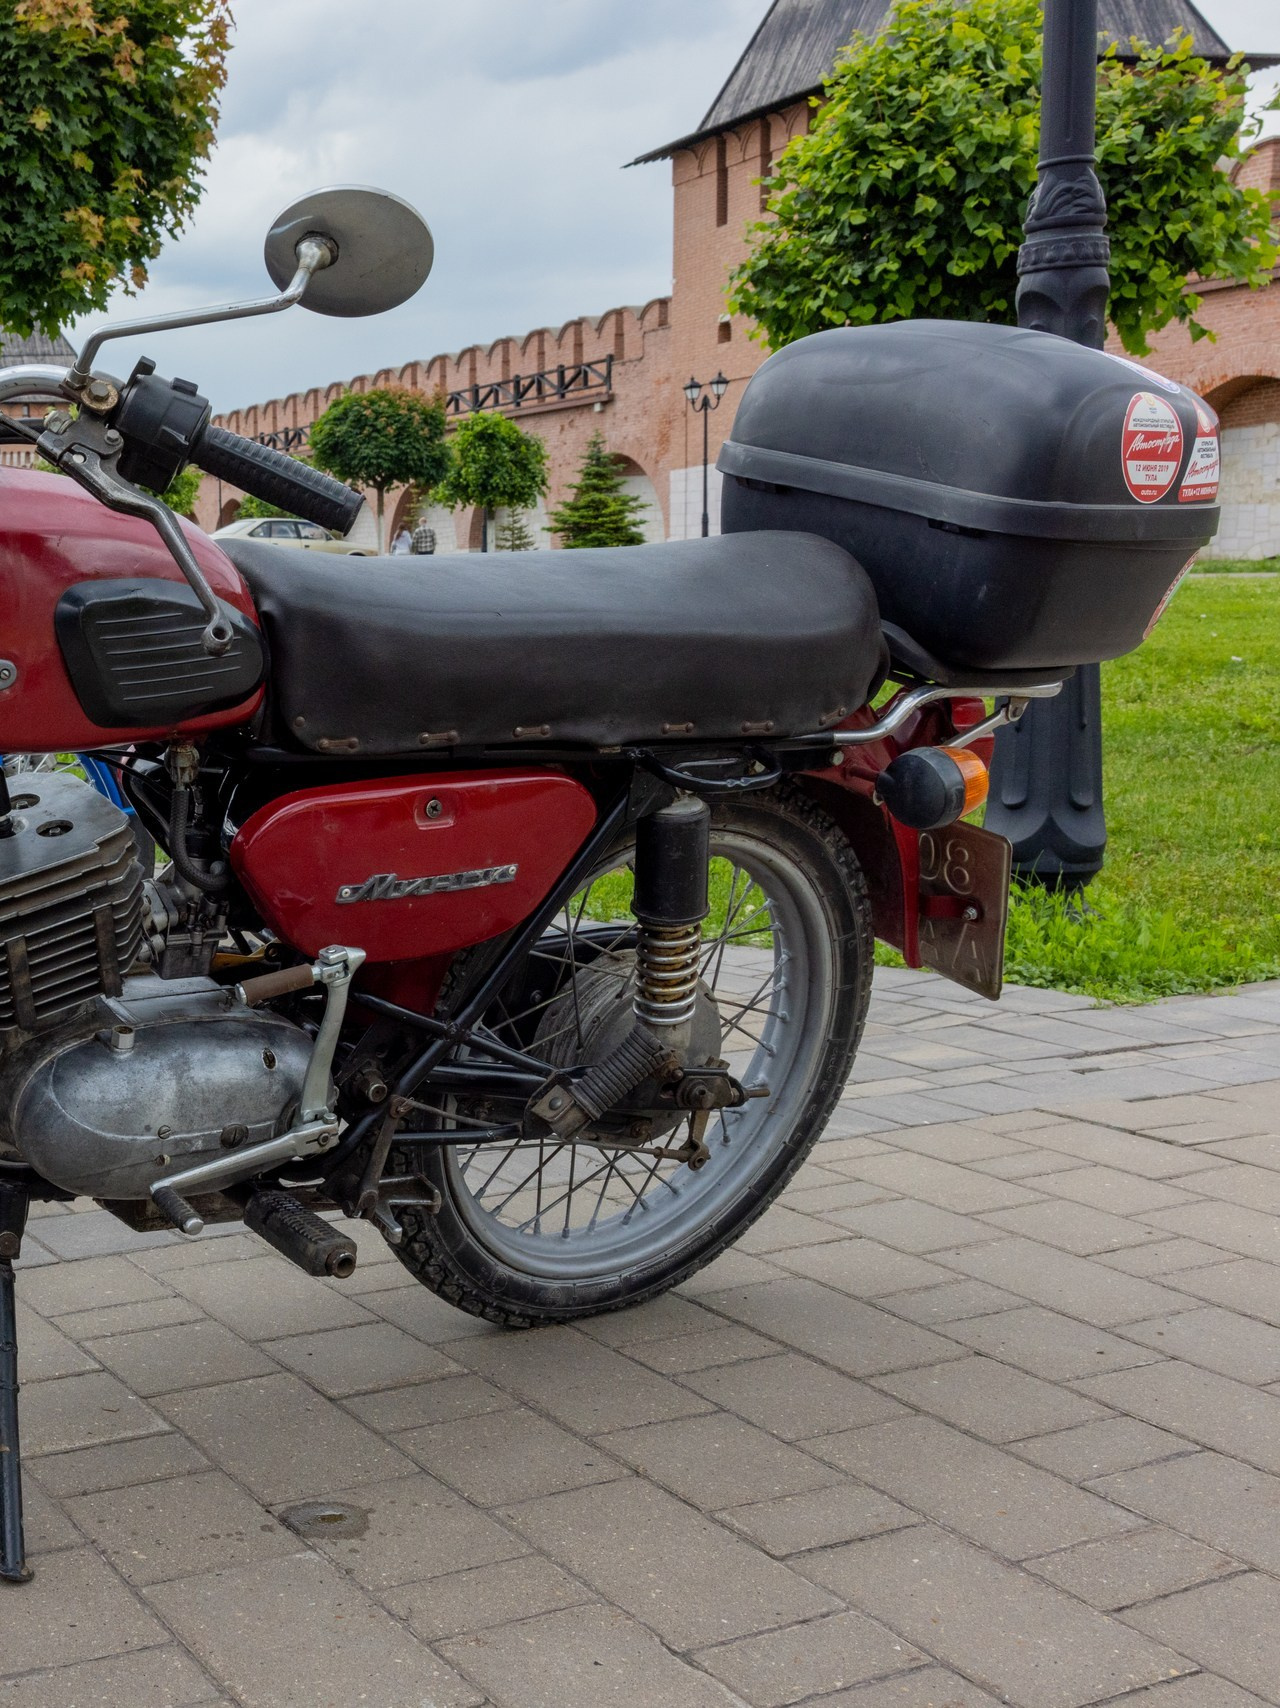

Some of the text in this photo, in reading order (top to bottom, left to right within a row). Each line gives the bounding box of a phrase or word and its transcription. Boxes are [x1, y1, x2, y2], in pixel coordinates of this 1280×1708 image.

[1136, 464, 1169, 472] 12 ИЮНЯ 2019
[1145, 474, 1157, 482] ТУЛА
